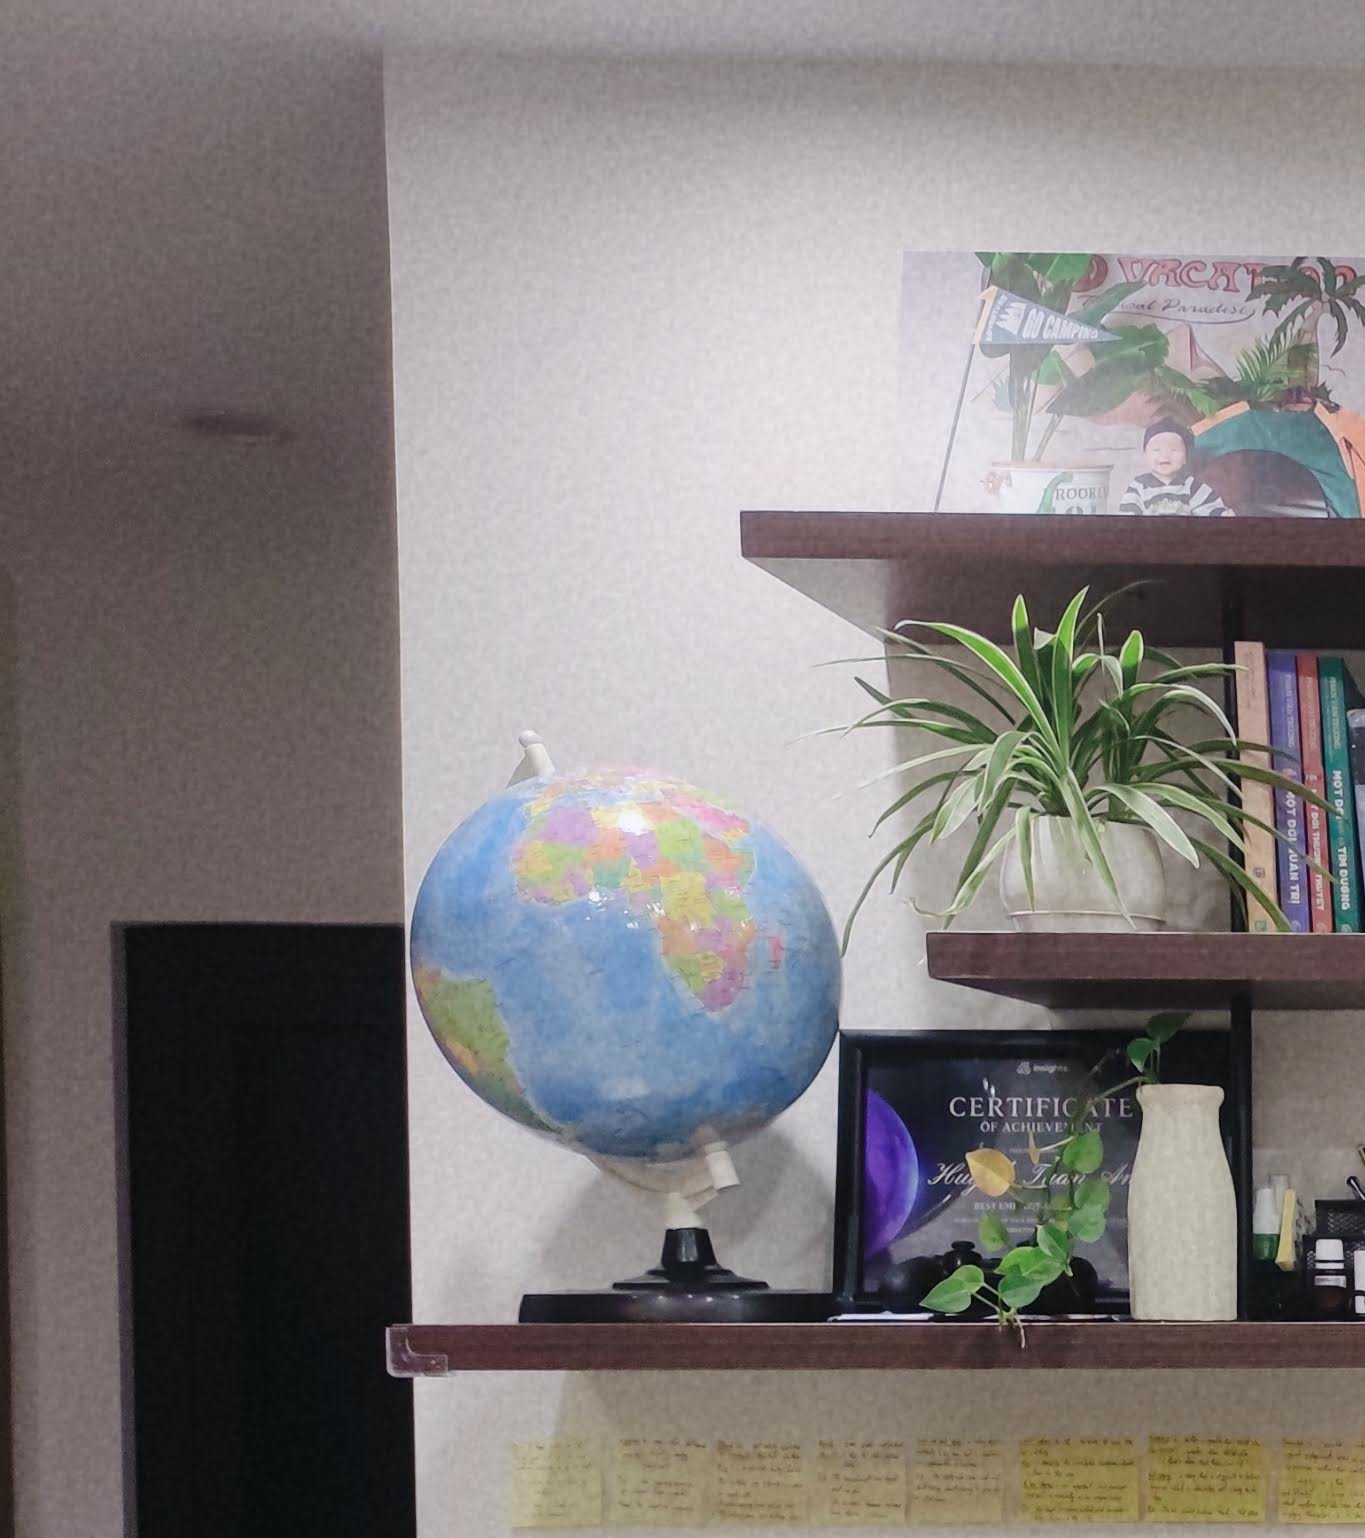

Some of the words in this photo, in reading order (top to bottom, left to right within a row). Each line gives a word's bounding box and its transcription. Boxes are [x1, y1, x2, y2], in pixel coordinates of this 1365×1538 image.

[1022, 308, 1046, 339] GO
[949, 1096, 1134, 1118] CERTIFICATE
[980, 1120, 998, 1133] OF
